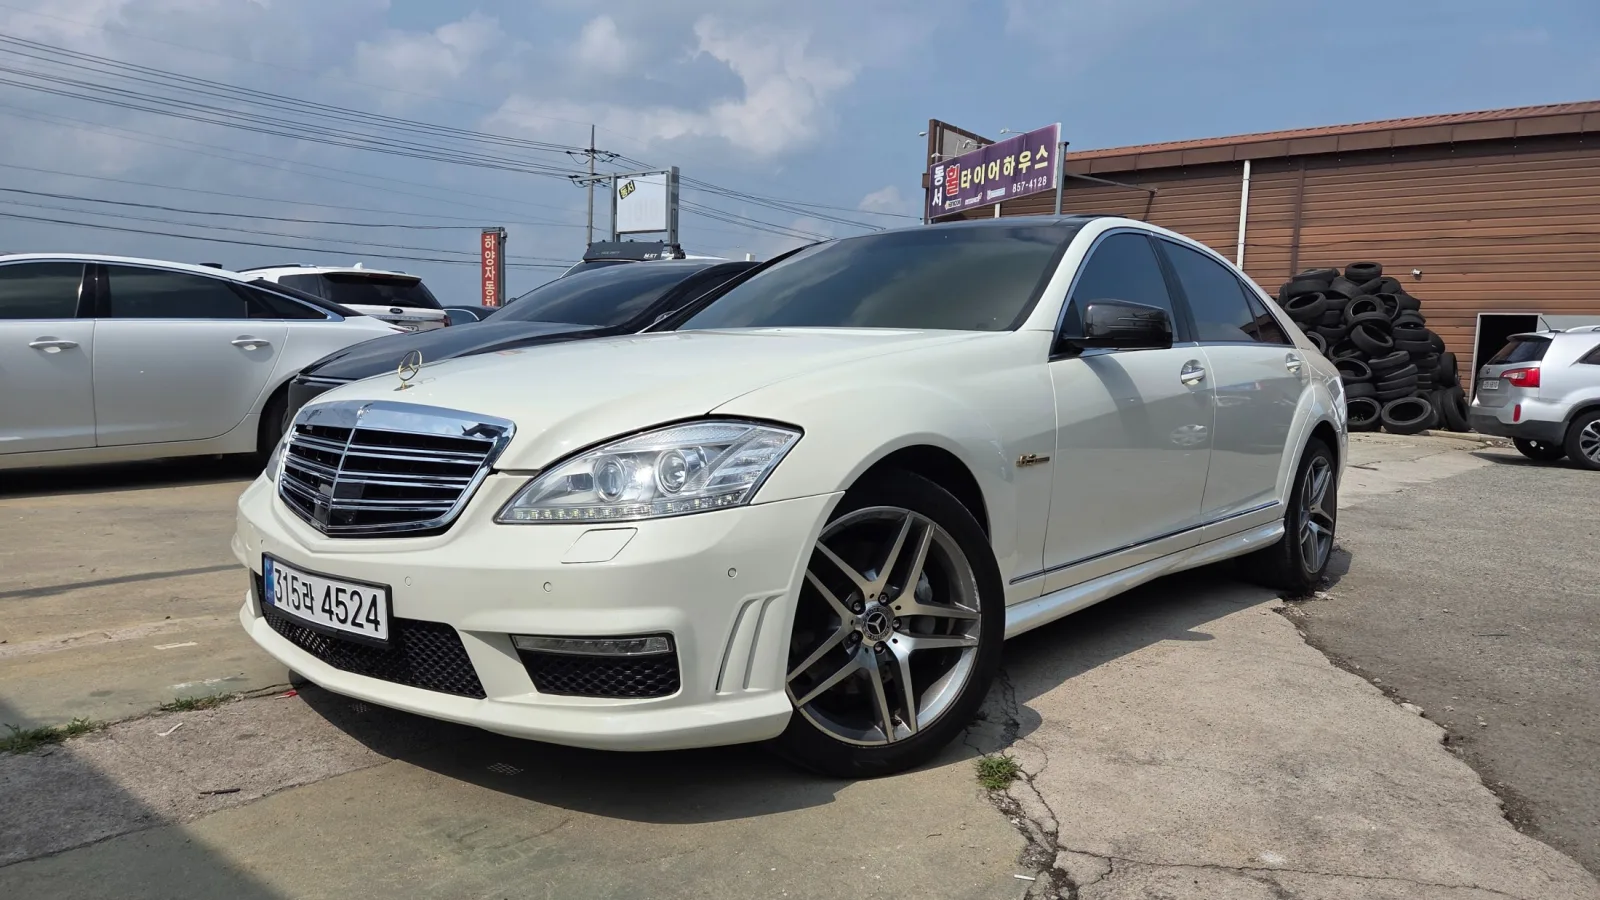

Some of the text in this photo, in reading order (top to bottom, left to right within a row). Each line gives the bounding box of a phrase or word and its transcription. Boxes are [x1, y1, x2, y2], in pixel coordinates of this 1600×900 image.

[1012, 175, 1047, 193] 857-4128
[484, 235, 496, 307] 하양자동차
[274, 567, 381, 632] 315라 4524
